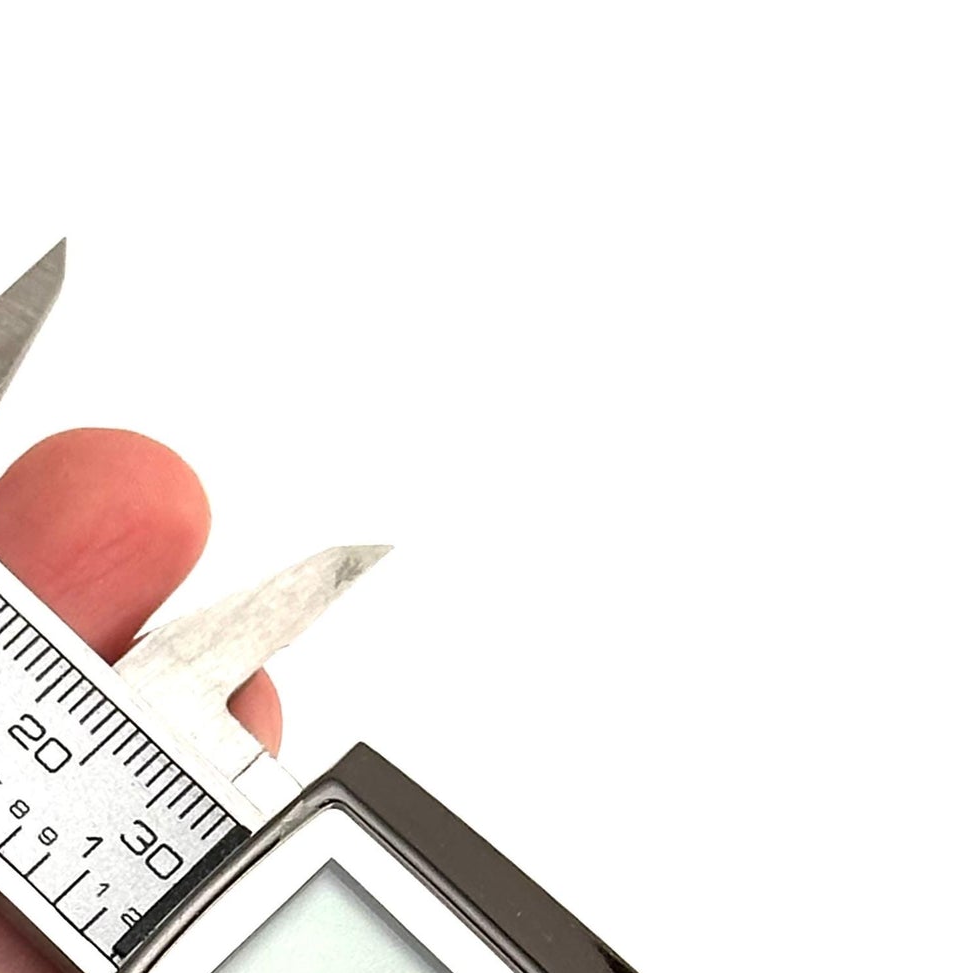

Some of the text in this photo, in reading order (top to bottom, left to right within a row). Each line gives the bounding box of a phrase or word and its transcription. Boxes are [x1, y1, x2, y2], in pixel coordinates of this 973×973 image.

[7, 713, 73, 773] 20
[9, 799, 31, 819] 8
[38, 826, 59, 846] 9
[83, 836, 104, 858] 1
[120, 819, 184, 880] 30
[97, 882, 110, 897] 1
